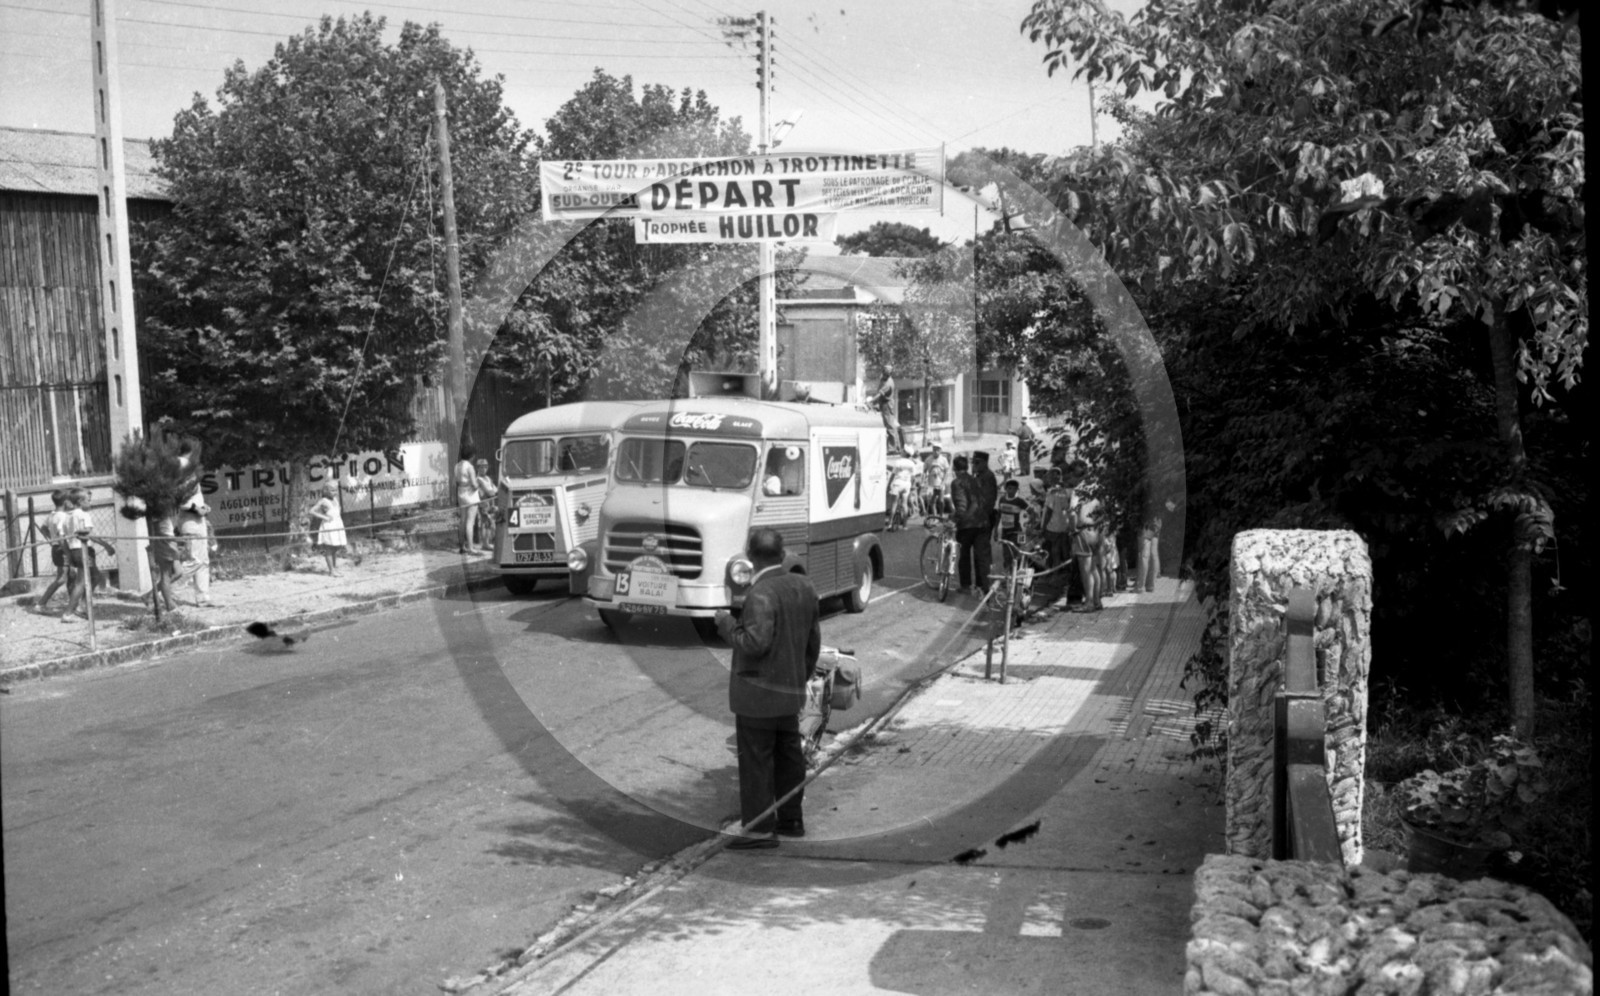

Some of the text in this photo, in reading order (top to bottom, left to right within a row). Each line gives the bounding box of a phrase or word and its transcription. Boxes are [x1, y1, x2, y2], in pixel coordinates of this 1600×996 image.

[592, 163, 637, 179] TOUR
[779, 153, 916, 172] TROTTINETTE
[553, 193, 637, 207] SUD-OUEST
[651, 179, 800, 210] DÉPART
[719, 214, 818, 239] HUILOR
[510, 510, 518, 525] 4
[616, 573, 629, 593] 13
[638, 581, 668, 590] VOITURE
